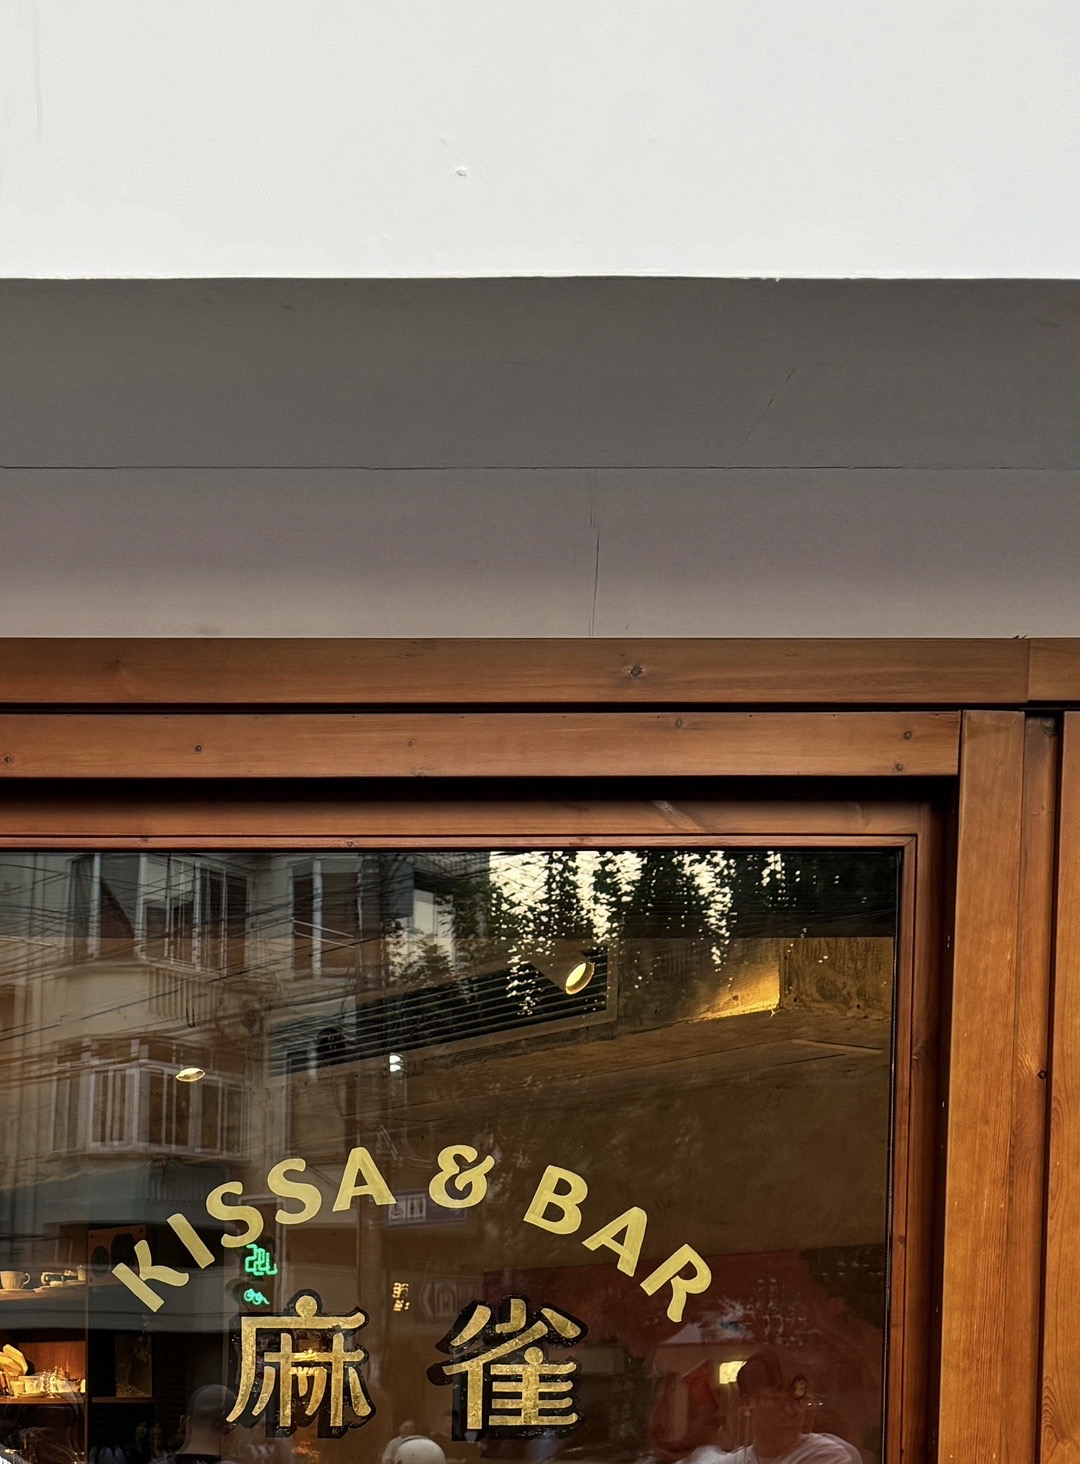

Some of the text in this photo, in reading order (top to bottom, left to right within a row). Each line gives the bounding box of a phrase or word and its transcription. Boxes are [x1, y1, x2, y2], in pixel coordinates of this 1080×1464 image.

[111, 1144, 713, 1323] KISSA & BAR
[224, 1292, 585, 1435] 麻雀
